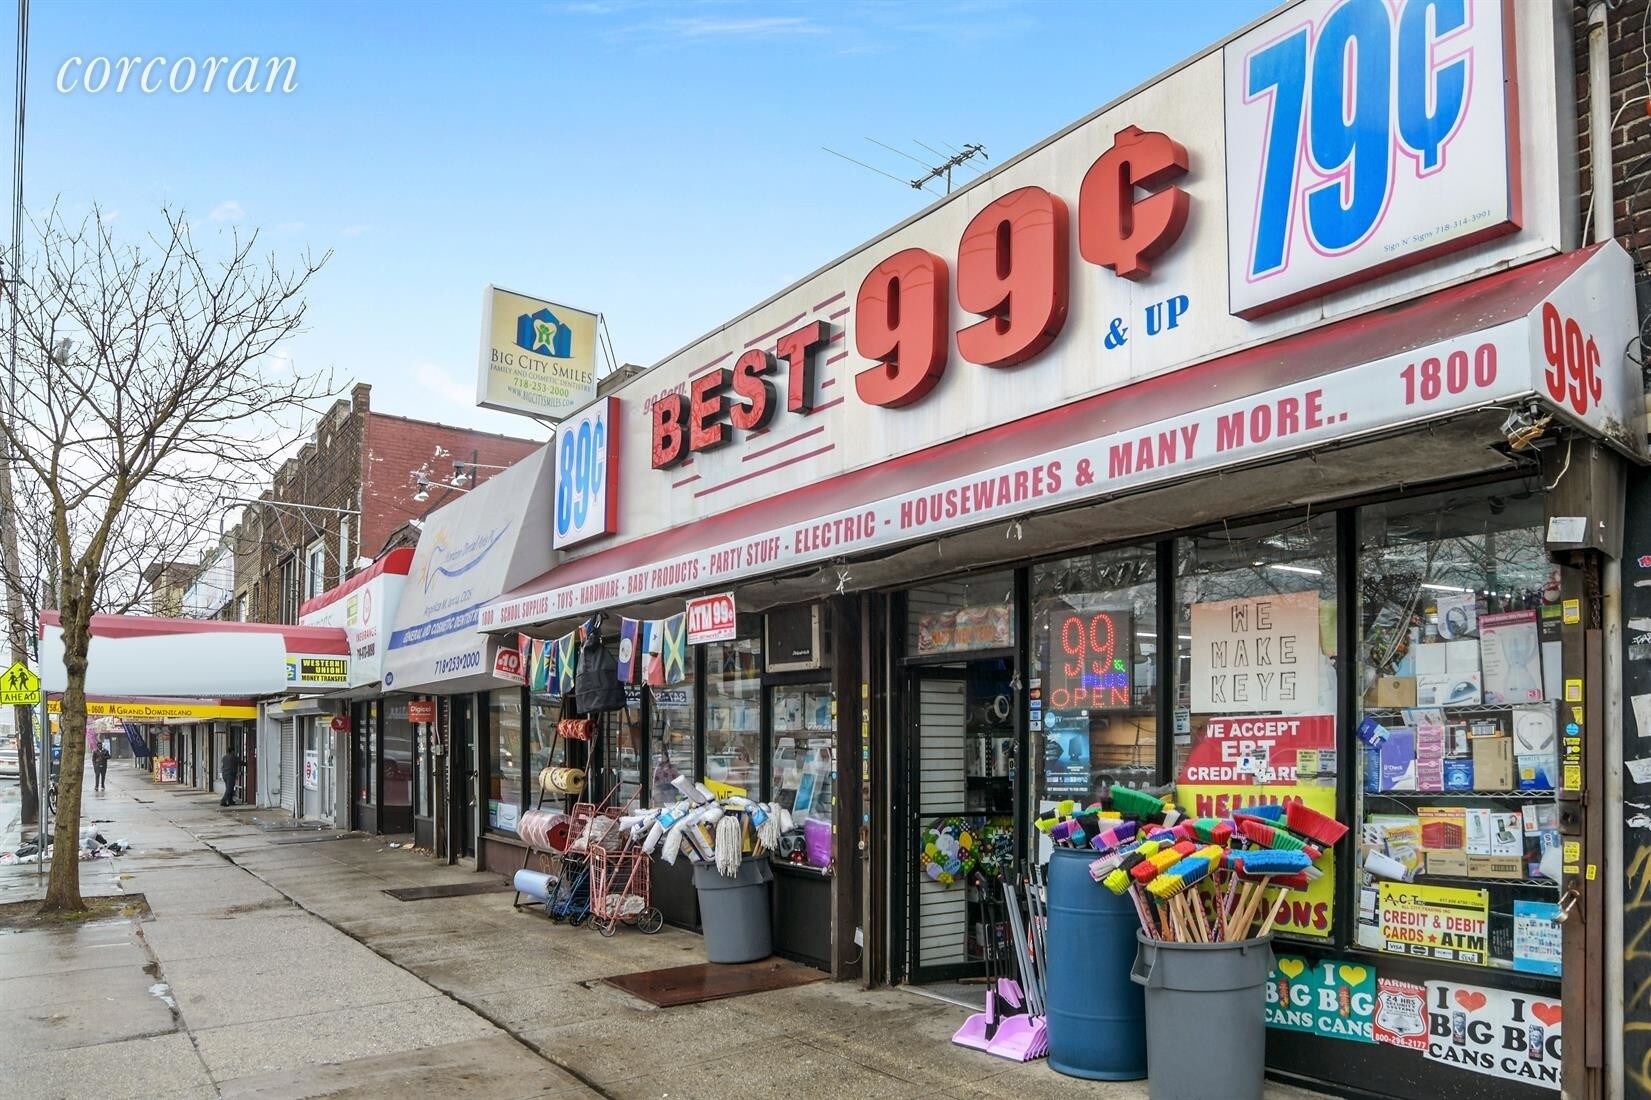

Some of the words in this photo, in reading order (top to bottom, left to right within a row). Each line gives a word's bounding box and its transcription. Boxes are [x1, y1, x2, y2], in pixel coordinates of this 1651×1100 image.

[1245, 0, 1472, 282] 79¢
[1104, 317, 1130, 350] &
[1145, 294, 1189, 336] UP
[1542, 302, 1602, 416] 99¢
[652, 320, 831, 470] BEST
[500, 604, 520, 623] SCHOOL
[522, 597, 549, 618] SUPPLIES
[557, 590, 573, 610] TOYS
[580, 579, 619, 604] HARDWARE
[627, 571, 649, 594] BABY
[652, 558, 698, 589] PRODUCTS
[710, 546, 742, 575] PARTY
[746, 536, 780, 566] STUFF
[794, 511, 875, 554] ELECTRIC
[900, 461, 1062, 530] HOUSEWARES
[1075, 457, 1094, 487] &
[1108, 423, 1199, 479] MANY
[1400, 343, 1497, 405] 1800
[557, 415, 605, 537] 89¢
[688, 602, 712, 633] ATM
[1231, 602, 1272, 632] WE
[1062, 613, 1114, 677] 99
[1211, 635, 1297, 668] MAKE
[1082, 673, 1128, 688] PLUS
[1211, 671, 1296, 703] KEYS
[5, 692, 36, 701] AHEAD
[1051, 687, 1129, 708] OPEN
[1229, 721, 1300, 737] ACCEPT
[1383, 910, 1428, 927] CREDIT
[1432, 915, 1441, 929] &
[1446, 917, 1485, 934] DEBIT
[1383, 925, 1424, 942] CARDS
[1441, 932, 1484, 951] ATM
[1389, 942, 1402, 950] VISA
[1323, 964, 1335, 985] I
[1437, 986, 1449, 1009] I
[1511, 998, 1525, 1022] I
[1265, 1008, 1313, 1027] CANS
[1318, 1016, 1373, 1038] CANS
[1375, 1033, 1426, 1049] 800-296-2177
[1428, 1043, 1494, 1069] CANS
[1501, 1057, 1561, 1083] CAN
